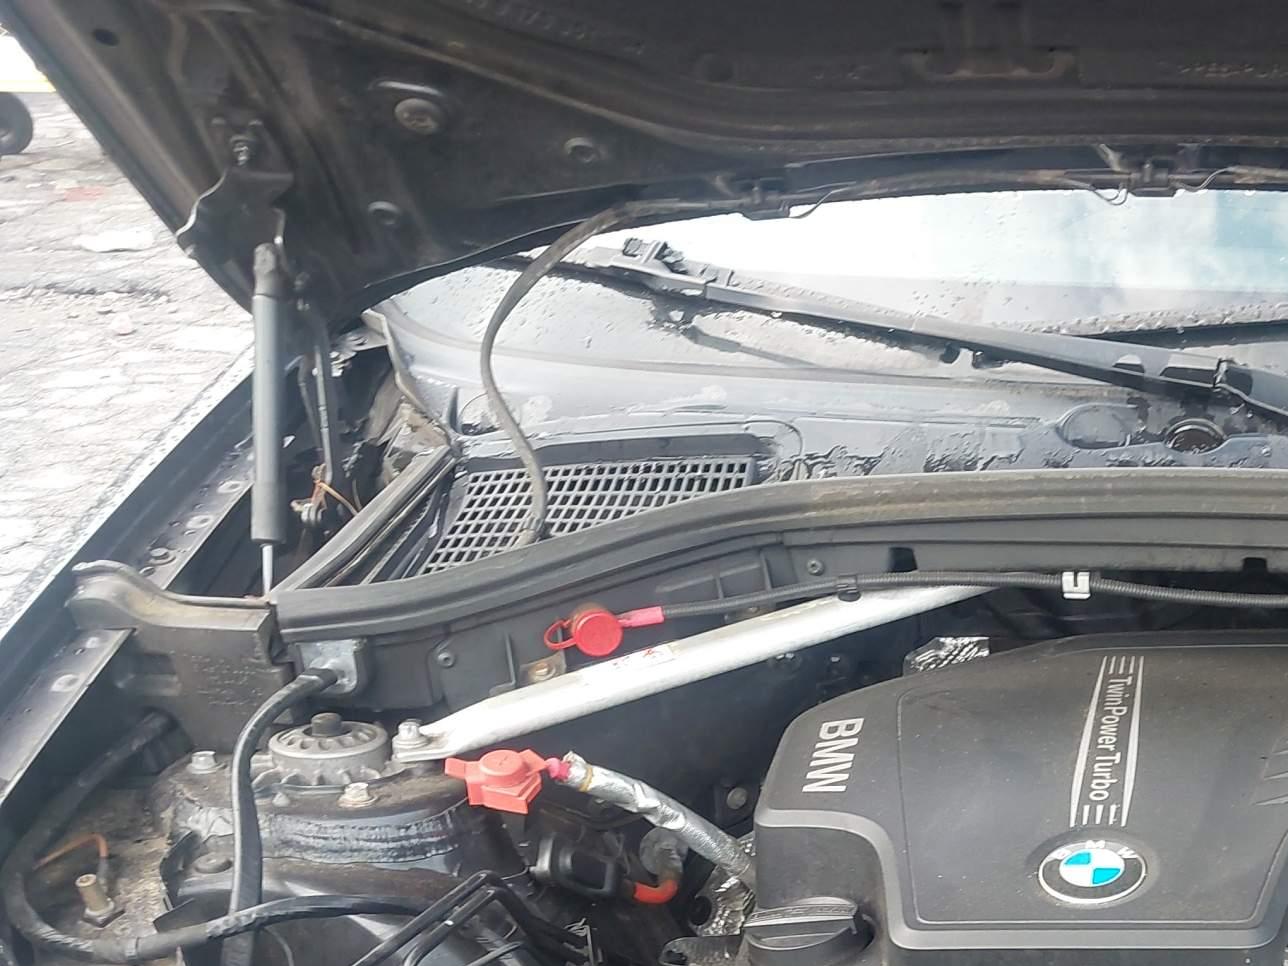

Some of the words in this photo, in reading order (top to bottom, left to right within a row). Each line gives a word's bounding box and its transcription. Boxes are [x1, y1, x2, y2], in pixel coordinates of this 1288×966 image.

[1096, 676, 1133, 751] TwinPower
[802, 717, 865, 793] BMW
[1089, 751, 1121, 801] Turbo
[1051, 839, 1139, 860] BMW
